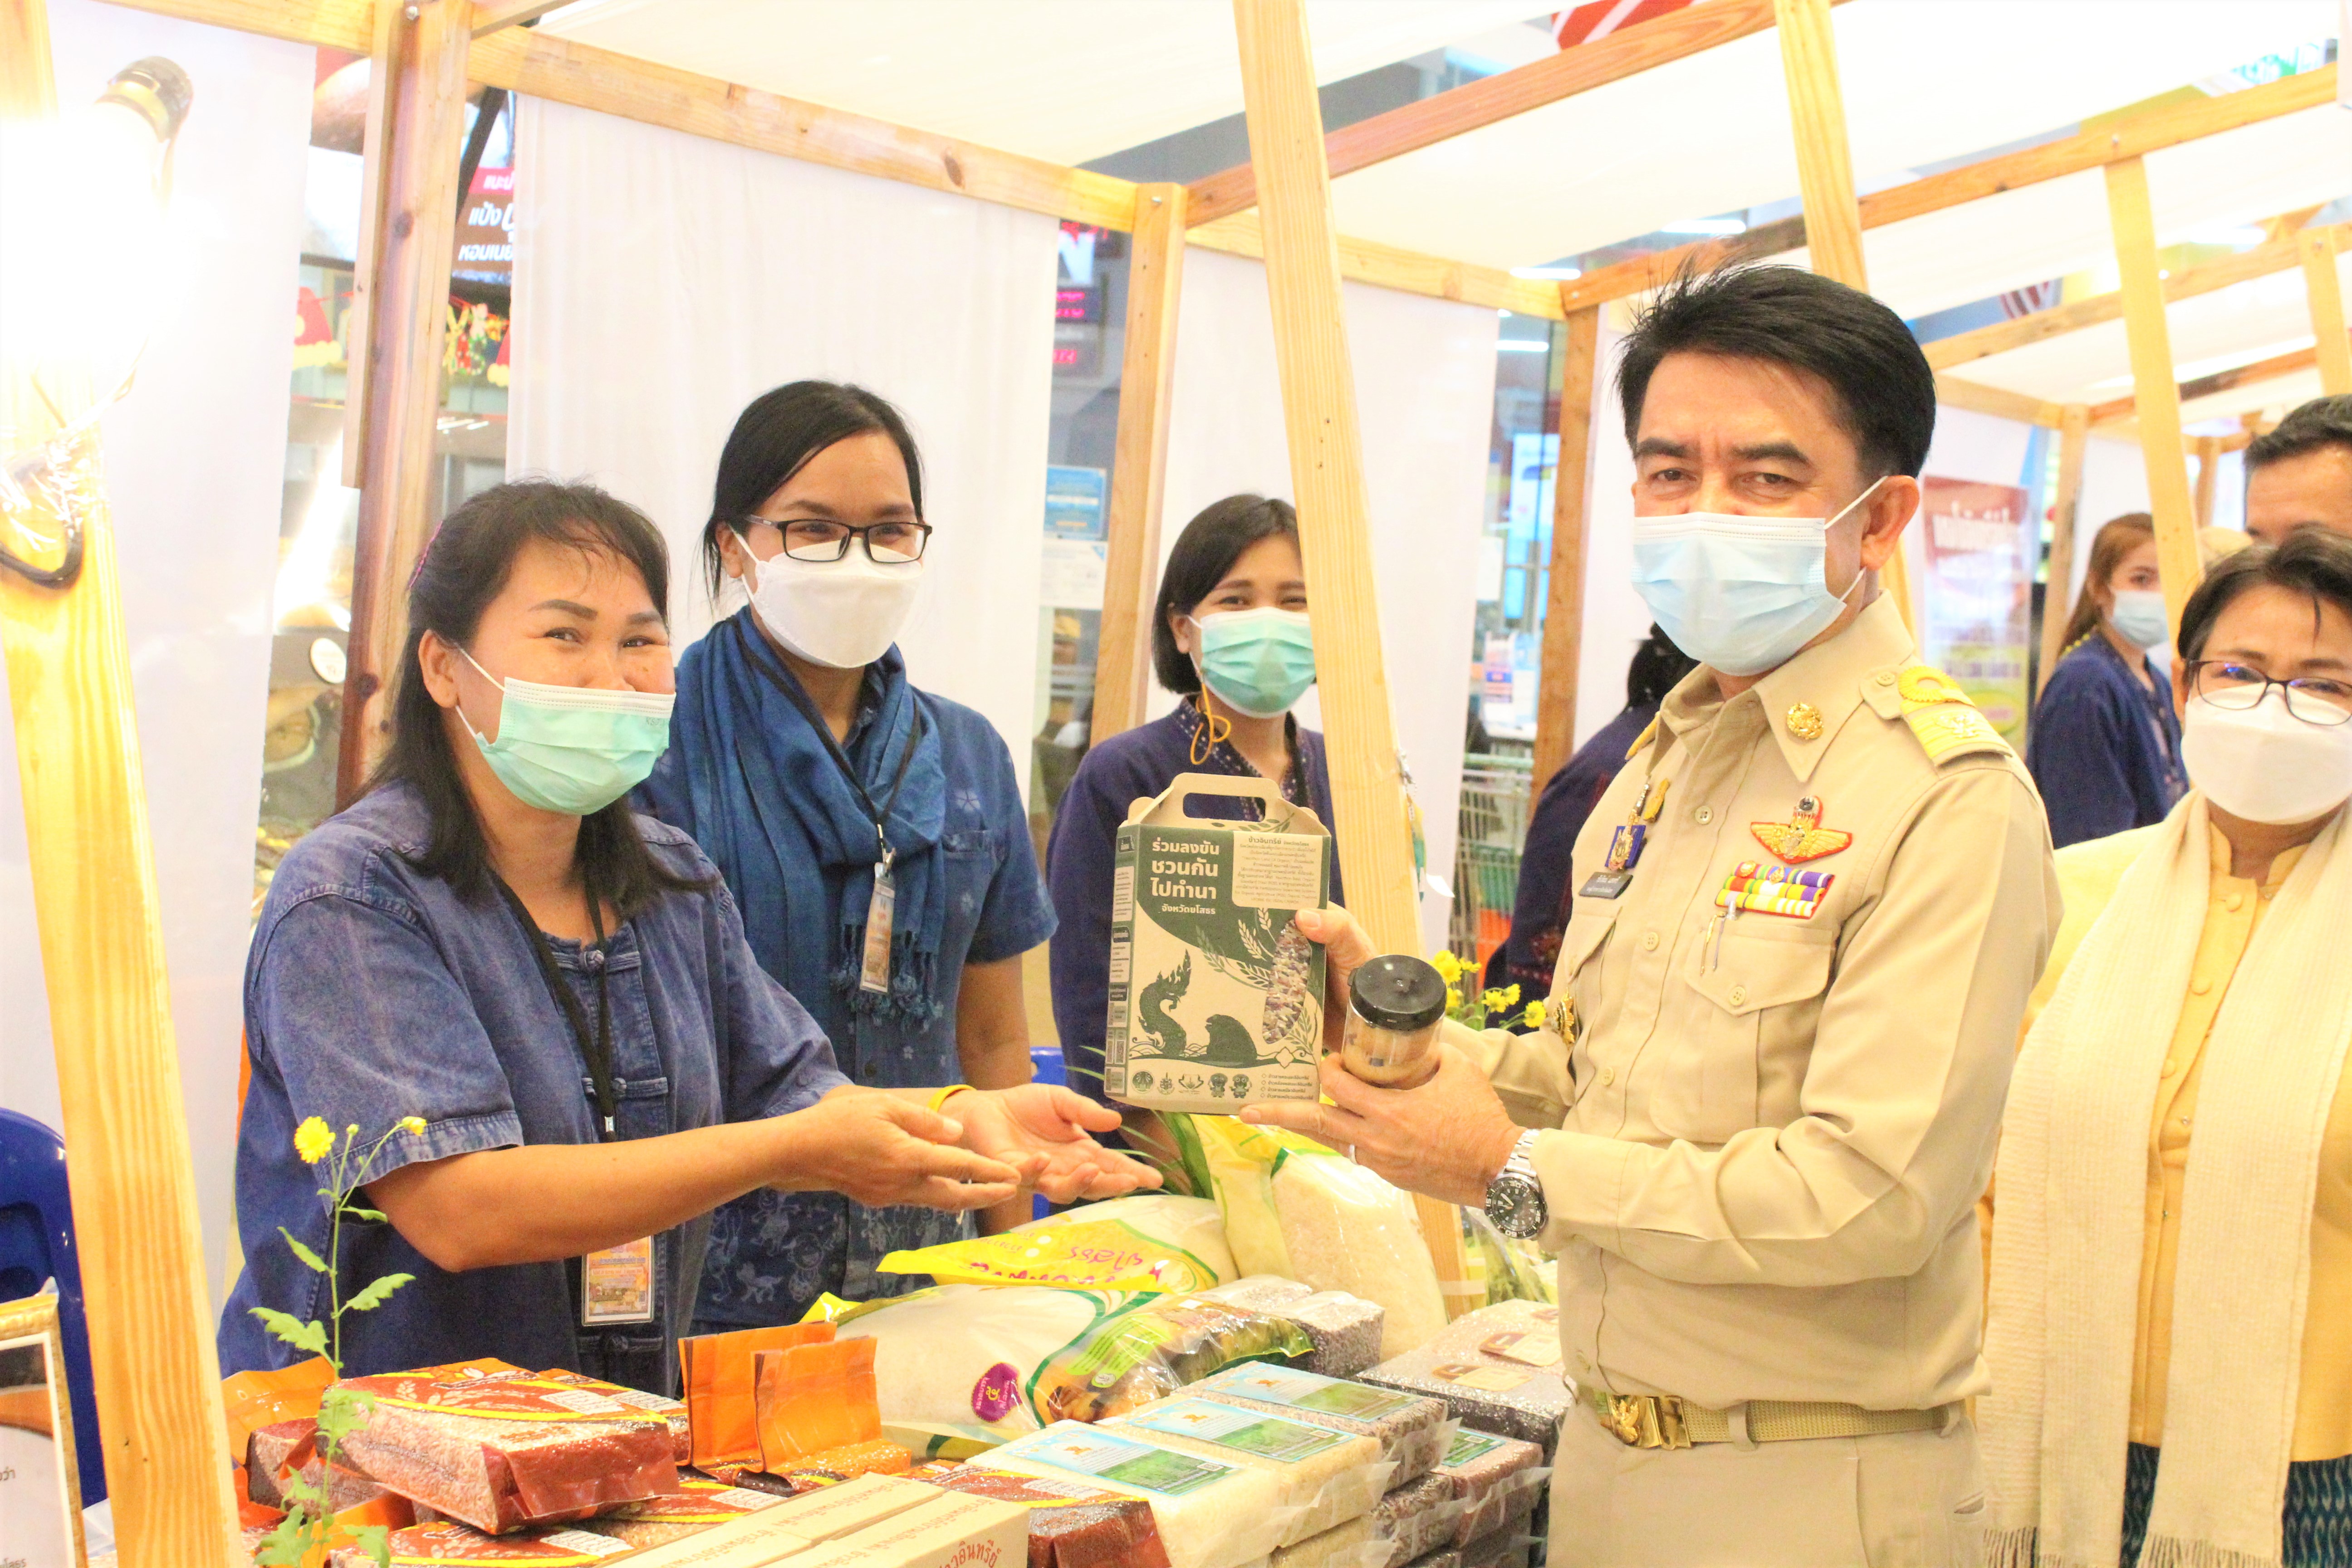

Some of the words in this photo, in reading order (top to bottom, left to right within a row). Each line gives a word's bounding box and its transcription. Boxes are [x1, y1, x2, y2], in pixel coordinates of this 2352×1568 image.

[1152, 837, 1220, 855] ร่วมลงขัน
[1249, 836, 1281, 844] ข้าวอินทรีย์
[1152, 857, 1218, 877] ชวนกัน
[1150, 877, 1217, 899] ไปทำนา
[1161, 903, 1216, 915] จังหวัดยโสธร
[1068, 1245, 1143, 1273] ยโสธร
[0, 1466, 15, 1481] ว่า
